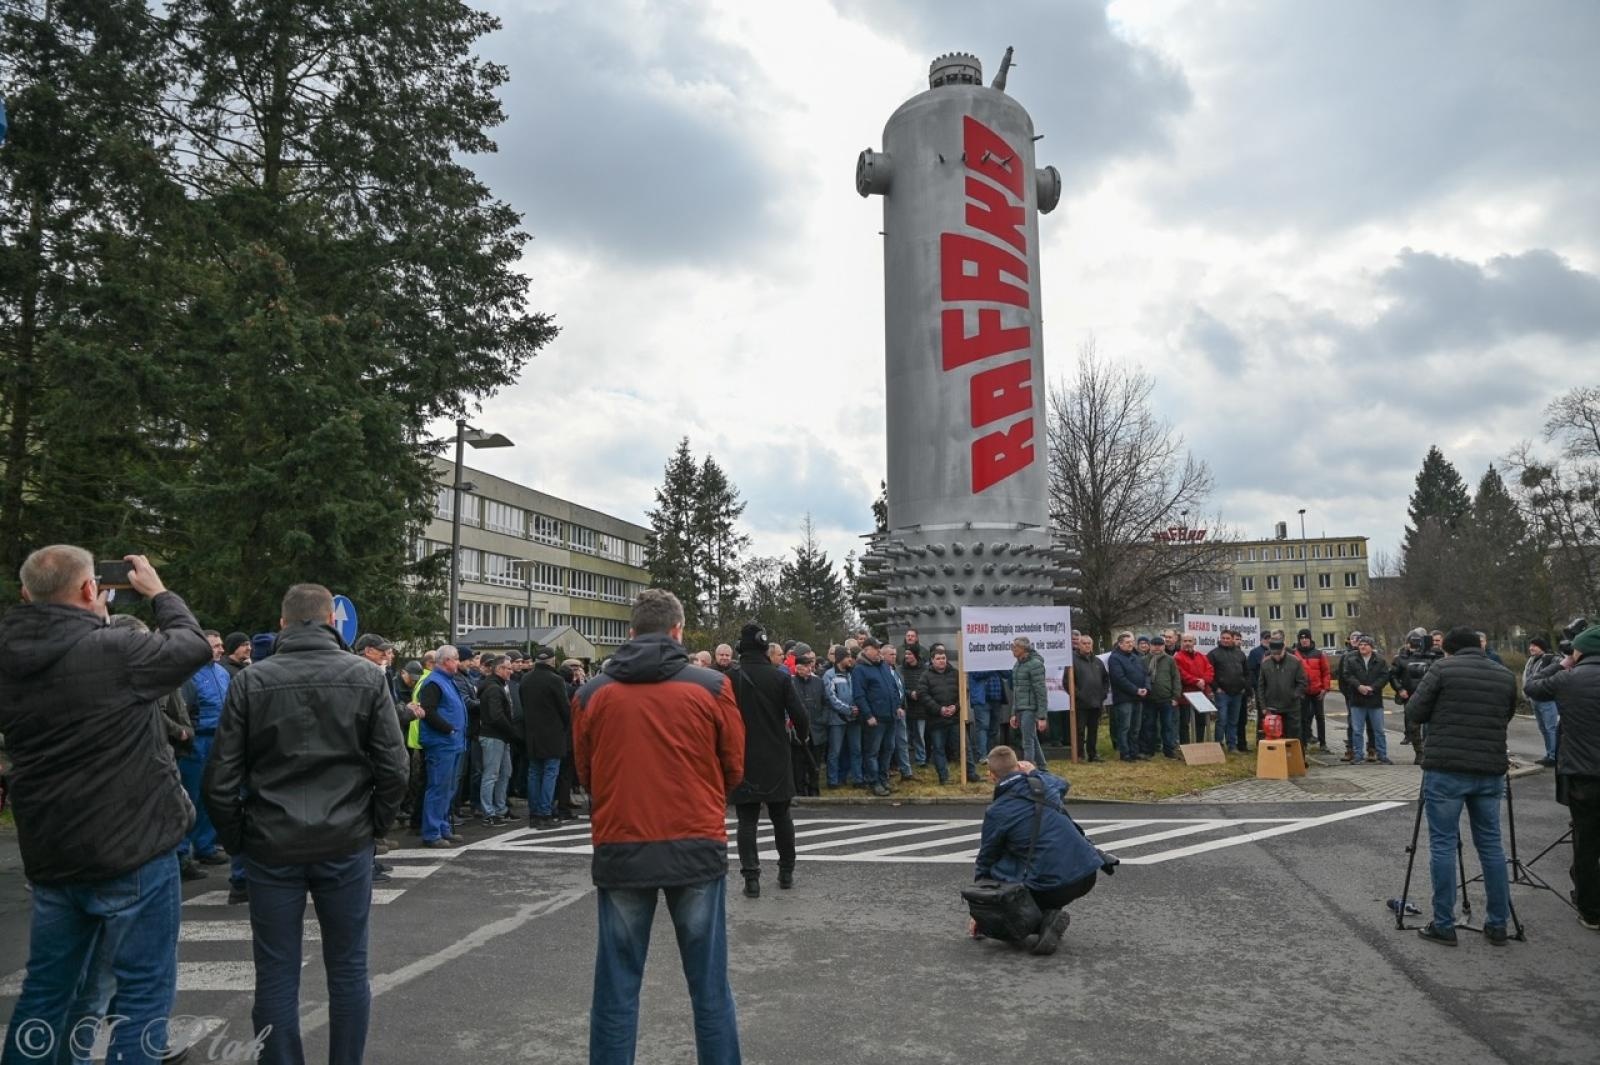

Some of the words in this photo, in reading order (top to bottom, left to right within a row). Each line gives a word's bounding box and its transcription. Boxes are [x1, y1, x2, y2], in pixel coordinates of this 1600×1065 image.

[940, 115, 1034, 494] RAFAKO
[967, 624, 988, 634] RAFAKO
[1014, 623, 1042, 633] zachodnie
[1188, 621, 1210, 632] RAFAKO
[969, 641, 986, 652] Cudze
[1036, 639, 1045, 649] nie
